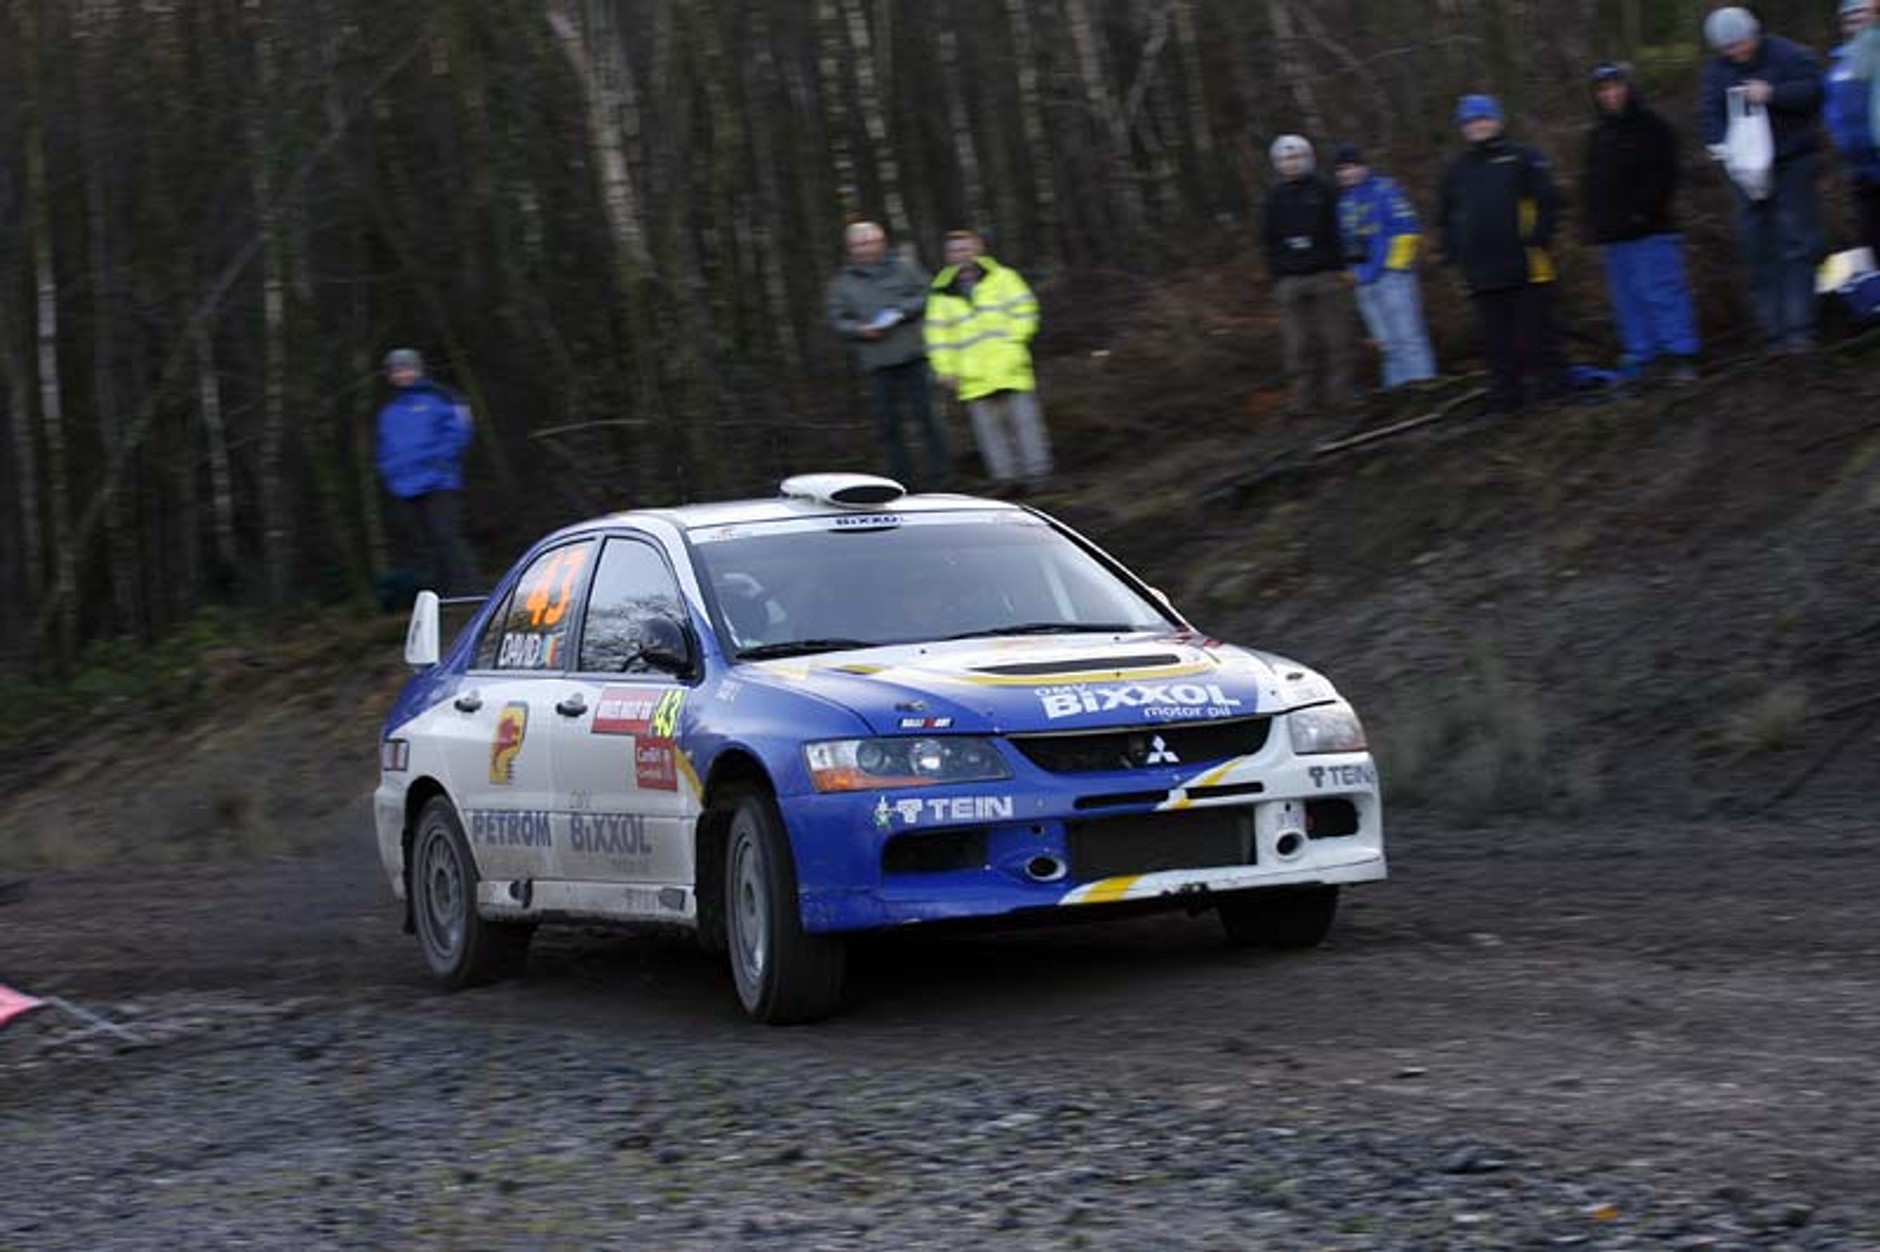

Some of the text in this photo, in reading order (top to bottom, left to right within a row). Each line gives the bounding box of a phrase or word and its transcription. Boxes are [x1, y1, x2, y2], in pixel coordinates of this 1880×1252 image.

[1042, 682, 1242, 719] BiXXOL
[1144, 705, 1232, 719] motor oil
[926, 795, 1014, 822] TEIN
[472, 810, 653, 854] PETROM BiXXOL
